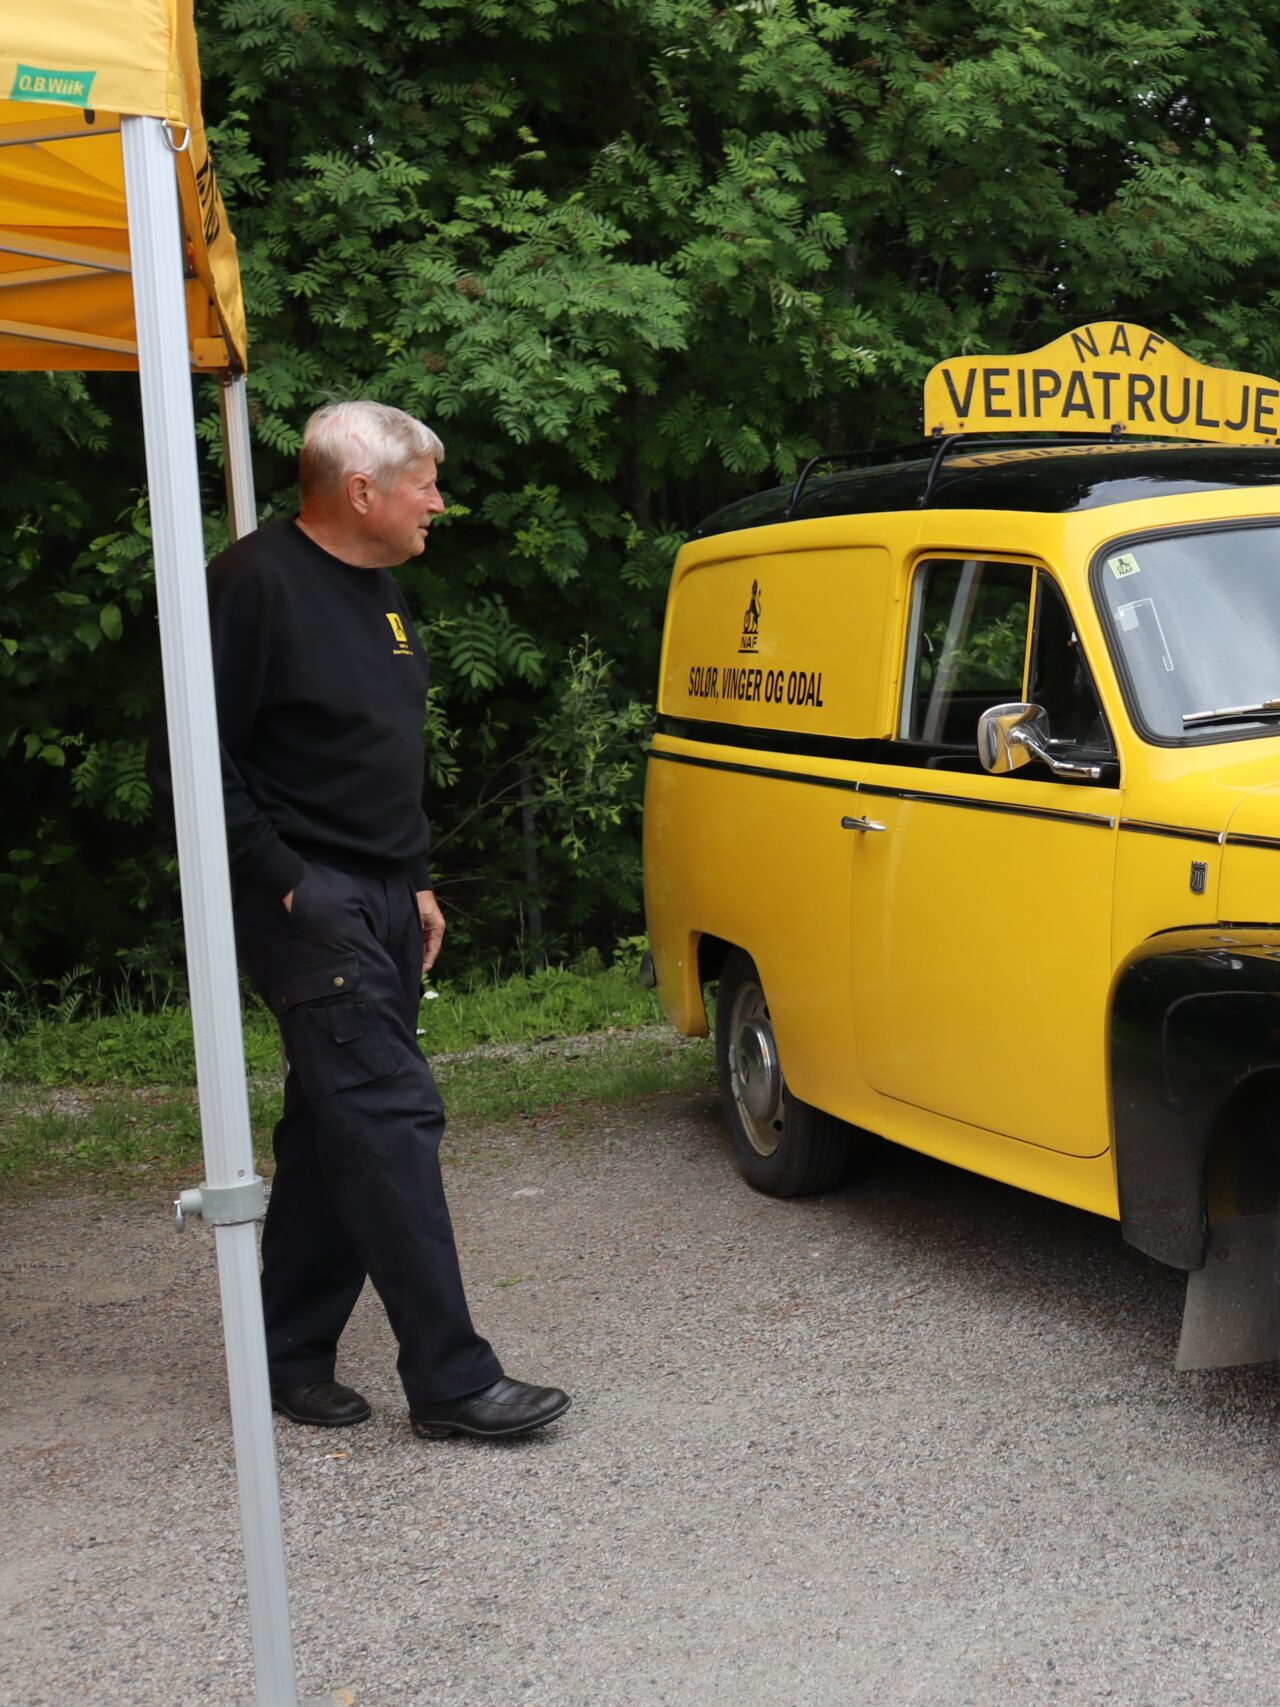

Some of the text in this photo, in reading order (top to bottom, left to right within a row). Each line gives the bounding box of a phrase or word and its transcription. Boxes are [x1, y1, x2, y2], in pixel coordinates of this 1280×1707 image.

[1070, 323, 1166, 364] NAF
[941, 367, 1280, 436] VEIPATRULJE
[740, 636, 758, 648] NAF
[688, 665, 824, 708] SOLØR, VINGER OG ODAL
